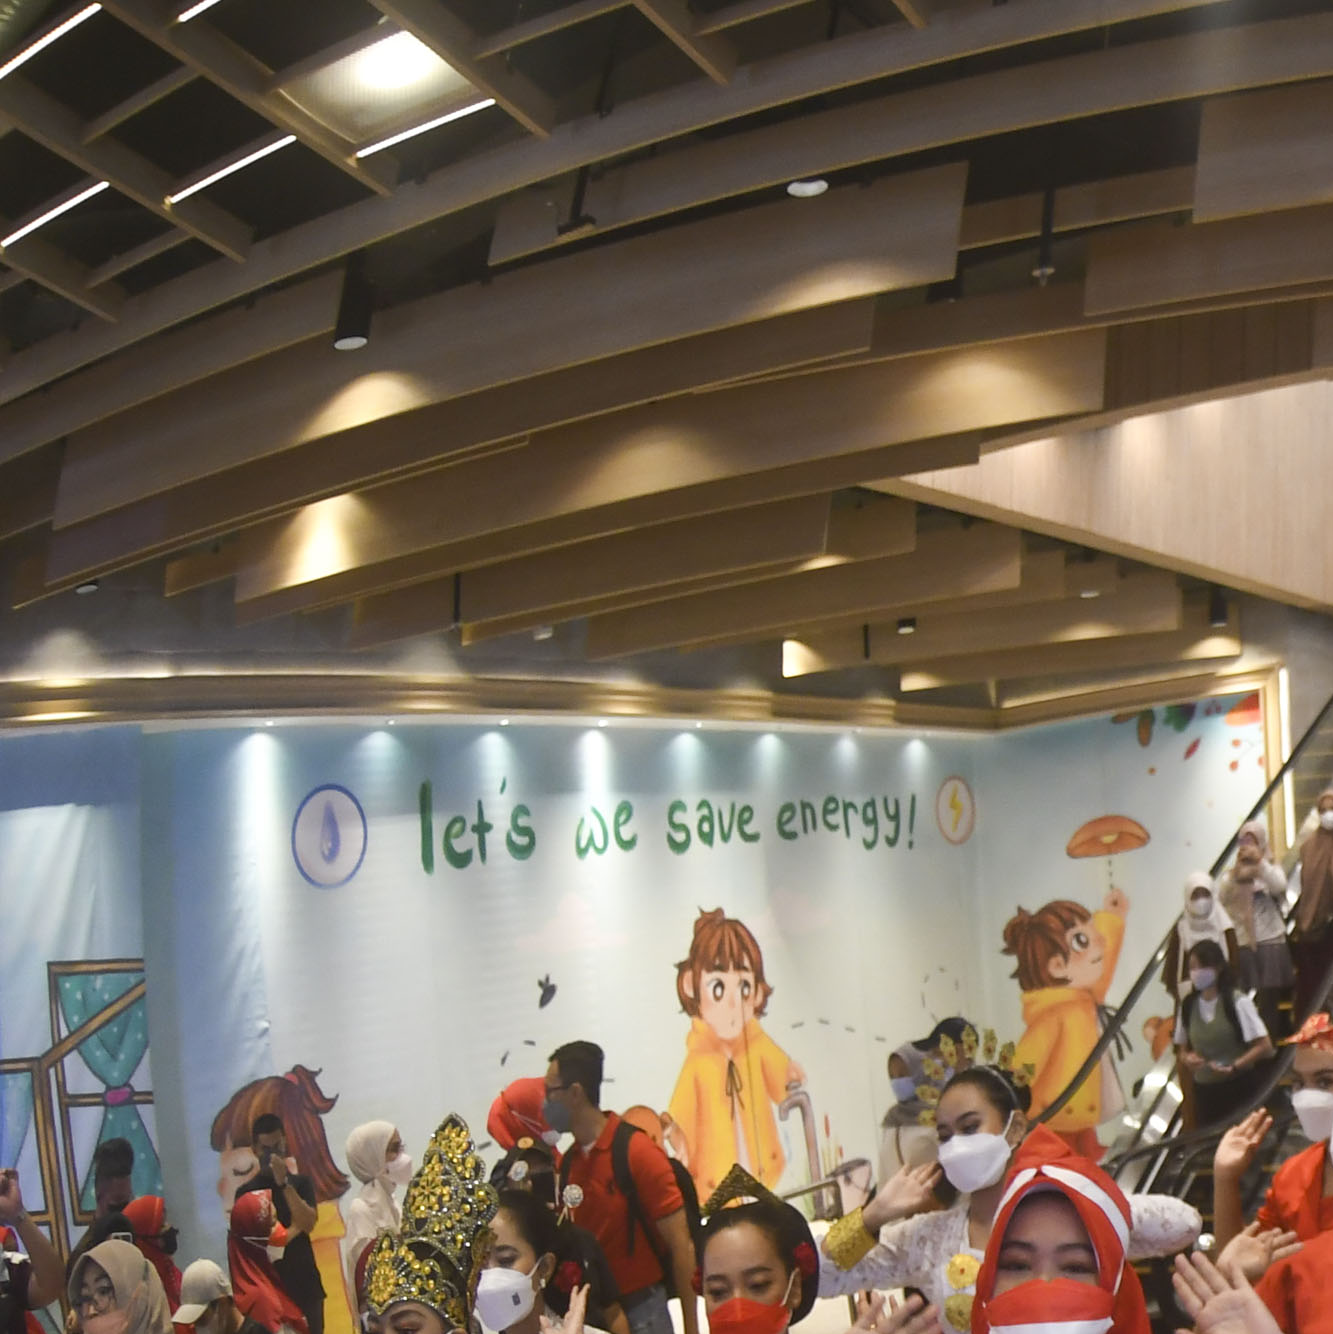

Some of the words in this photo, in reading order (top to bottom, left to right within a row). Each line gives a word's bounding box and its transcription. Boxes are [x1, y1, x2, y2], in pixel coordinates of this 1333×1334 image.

[575, 800, 638, 860] we
[666, 798, 760, 856] save
[776, 794, 916, 850] energy!
